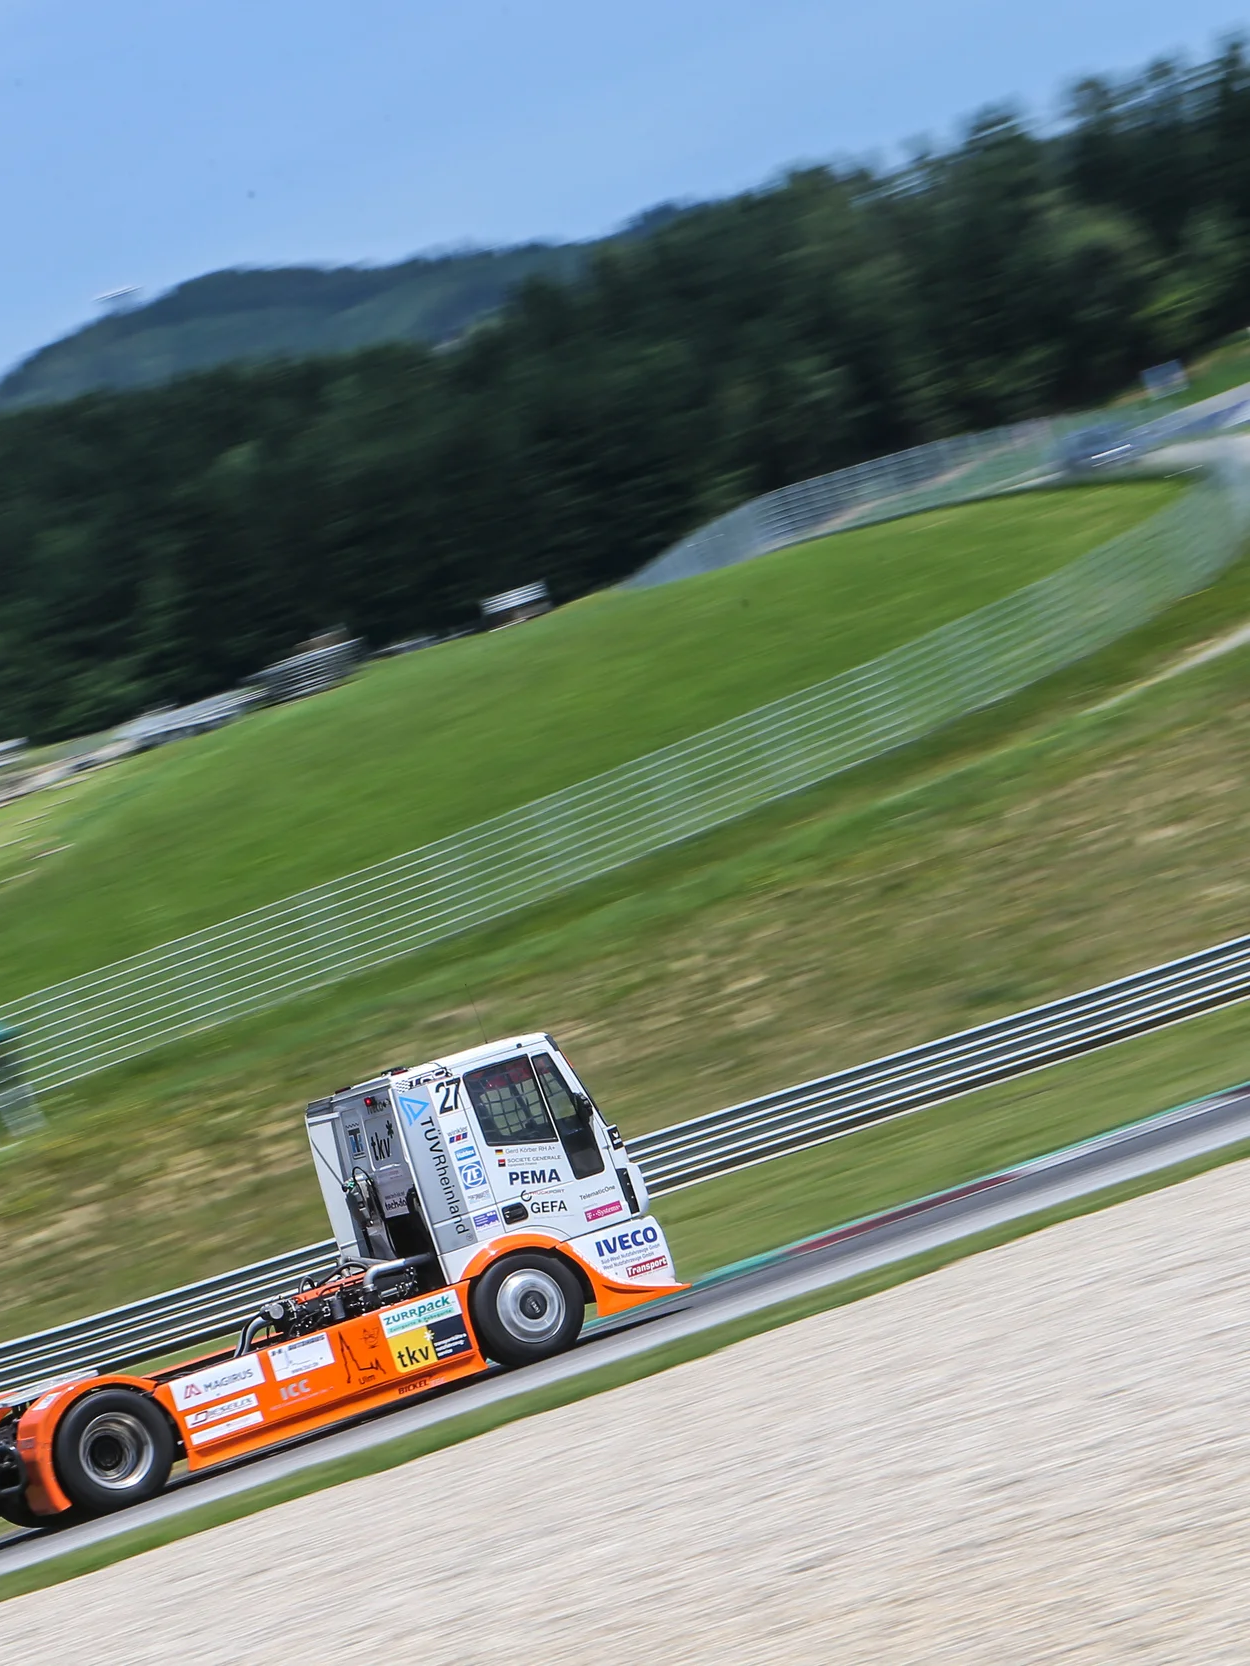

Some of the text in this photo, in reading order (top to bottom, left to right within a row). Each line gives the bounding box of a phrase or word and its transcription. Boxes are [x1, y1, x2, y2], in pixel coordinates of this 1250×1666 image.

[435, 1077, 461, 1115] 27
[370, 1132, 391, 1161] tkv
[505, 1147, 519, 1155] Gerd
[520, 1145, 537, 1154] Körber
[507, 1154, 562, 1164] SOCIETE GENERALE
[463, 1168, 483, 1184] ZF
[509, 1169, 562, 1185] PEMA
[579, 1185, 616, 1201] TelematicOne
[530, 1200, 568, 1214] GEFA
[595, 1226, 658, 1257] IVECO
[626, 1257, 668, 1277] Transport
[397, 1346, 429, 1368] tkv
[203, 1368, 254, 1392] MAGIRUS
[358, 1375, 376, 1385] Ulm
[398, 1379, 431, 1395] BICKEL
[279, 1379, 312, 1401] ICC
